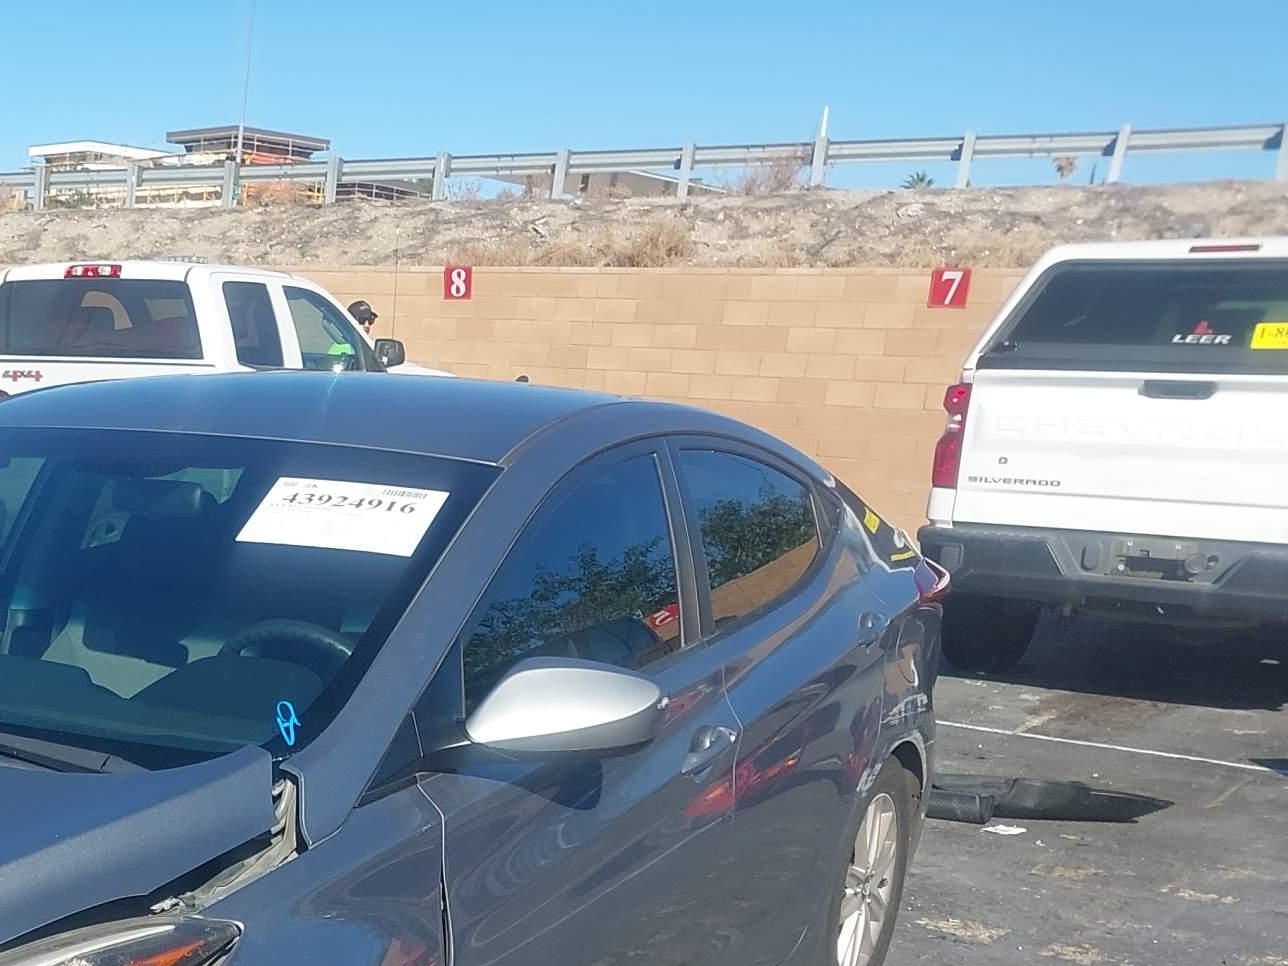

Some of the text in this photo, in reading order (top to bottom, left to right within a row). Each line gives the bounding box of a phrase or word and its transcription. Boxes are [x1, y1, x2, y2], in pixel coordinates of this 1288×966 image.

[450, 268, 467, 297] 8
[941, 271, 964, 305] 7
[1172, 334, 1232, 345] LEER
[967, 475, 1062, 487] SILVERADO
[283, 492, 418, 514] 43924916
